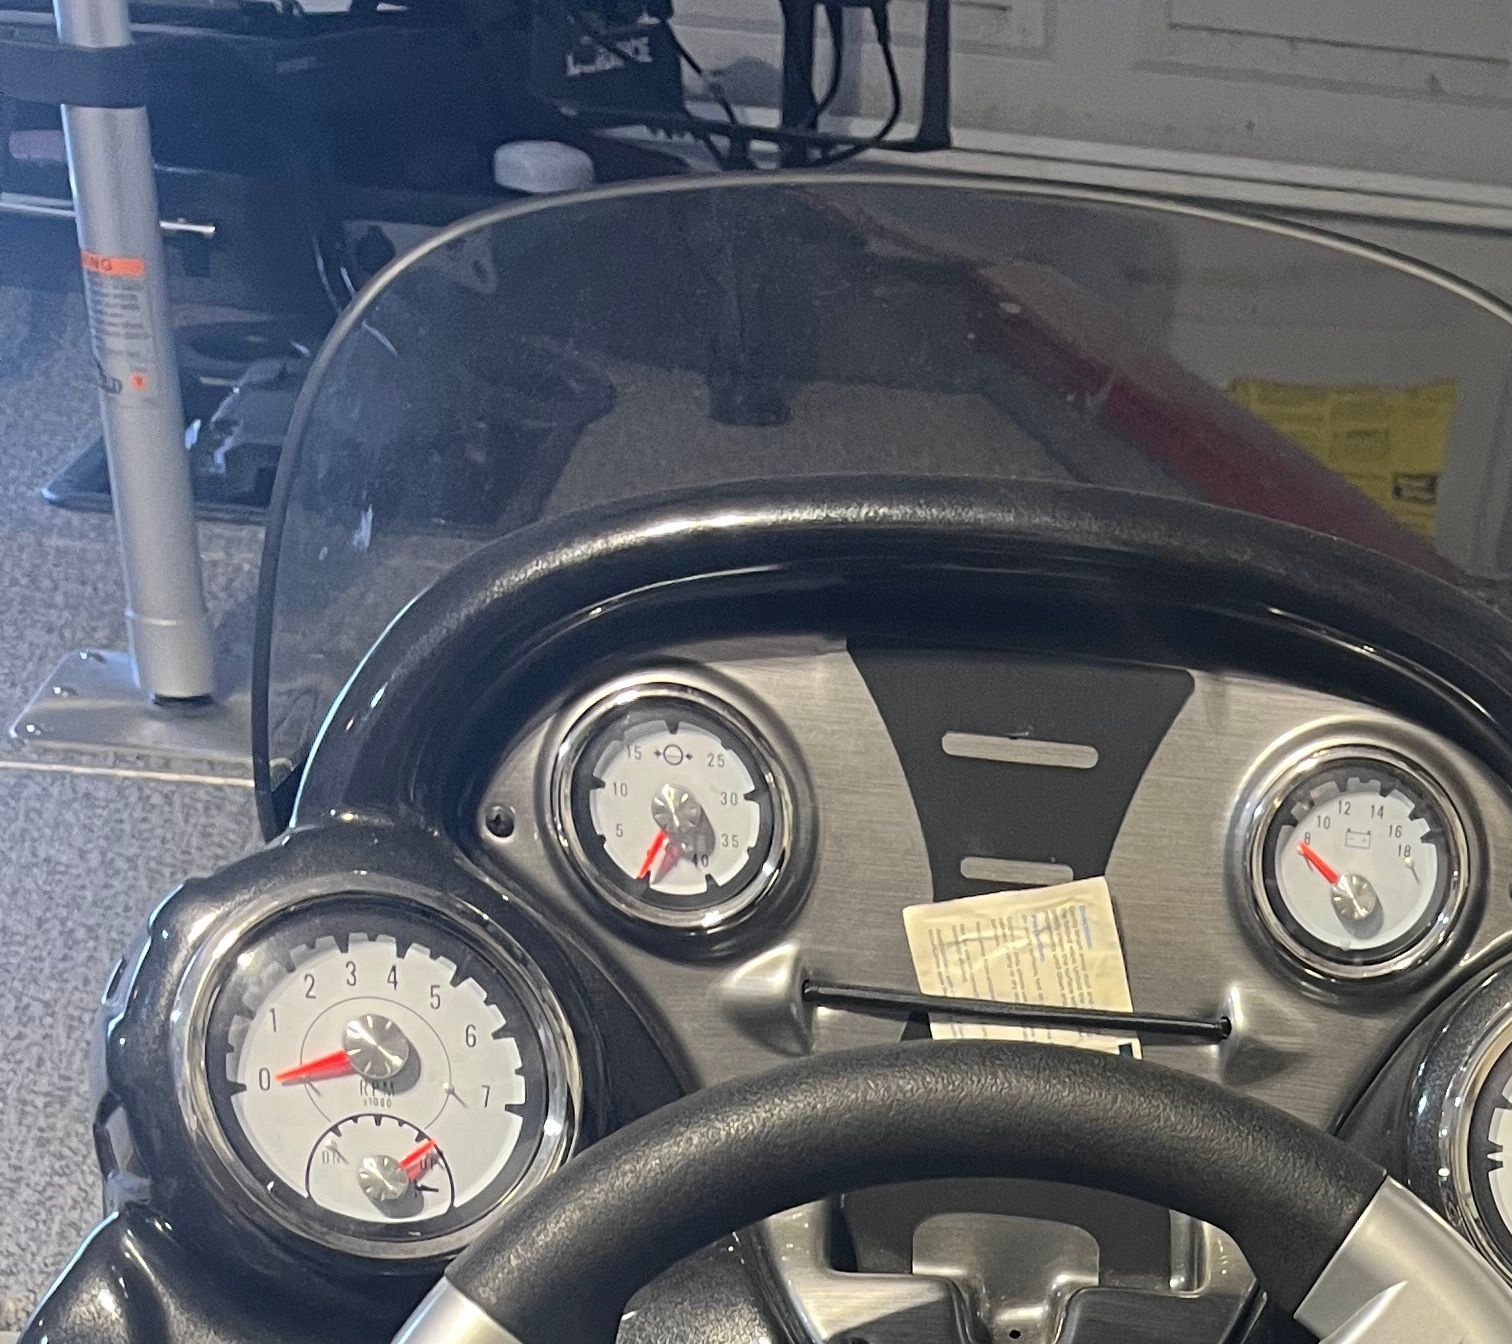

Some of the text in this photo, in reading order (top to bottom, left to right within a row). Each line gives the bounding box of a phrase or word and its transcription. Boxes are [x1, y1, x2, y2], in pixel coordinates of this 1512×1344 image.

[626, 745, 642, 760] 15
[707, 753, 725, 768] 25
[613, 782, 628, 797] 10
[720, 792, 738, 806] 30
[1338, 800, 1351, 816] 12
[1370, 804, 1384, 819] 14
[1317, 815, 1331, 829] 10
[616, 823, 624, 838] 5
[1304, 831, 1312, 845] 8
[1388, 824, 1402, 839] 16
[721, 833, 739, 848] 35
[1398, 845, 1412, 858] 18
[691, 854, 709, 869] 40
[345, 961, 357, 987] 3
[387, 964, 399, 990] 4
[304, 974, 316, 999] 2
[430, 984, 442, 1010] 5
[268, 1007, 277, 1033] 1
[465, 1024, 477, 1048] 6
[258, 1067, 271, 1091] 0
[360, 1080, 395, 1097] RPM
[480, 1084, 491, 1109] 7
